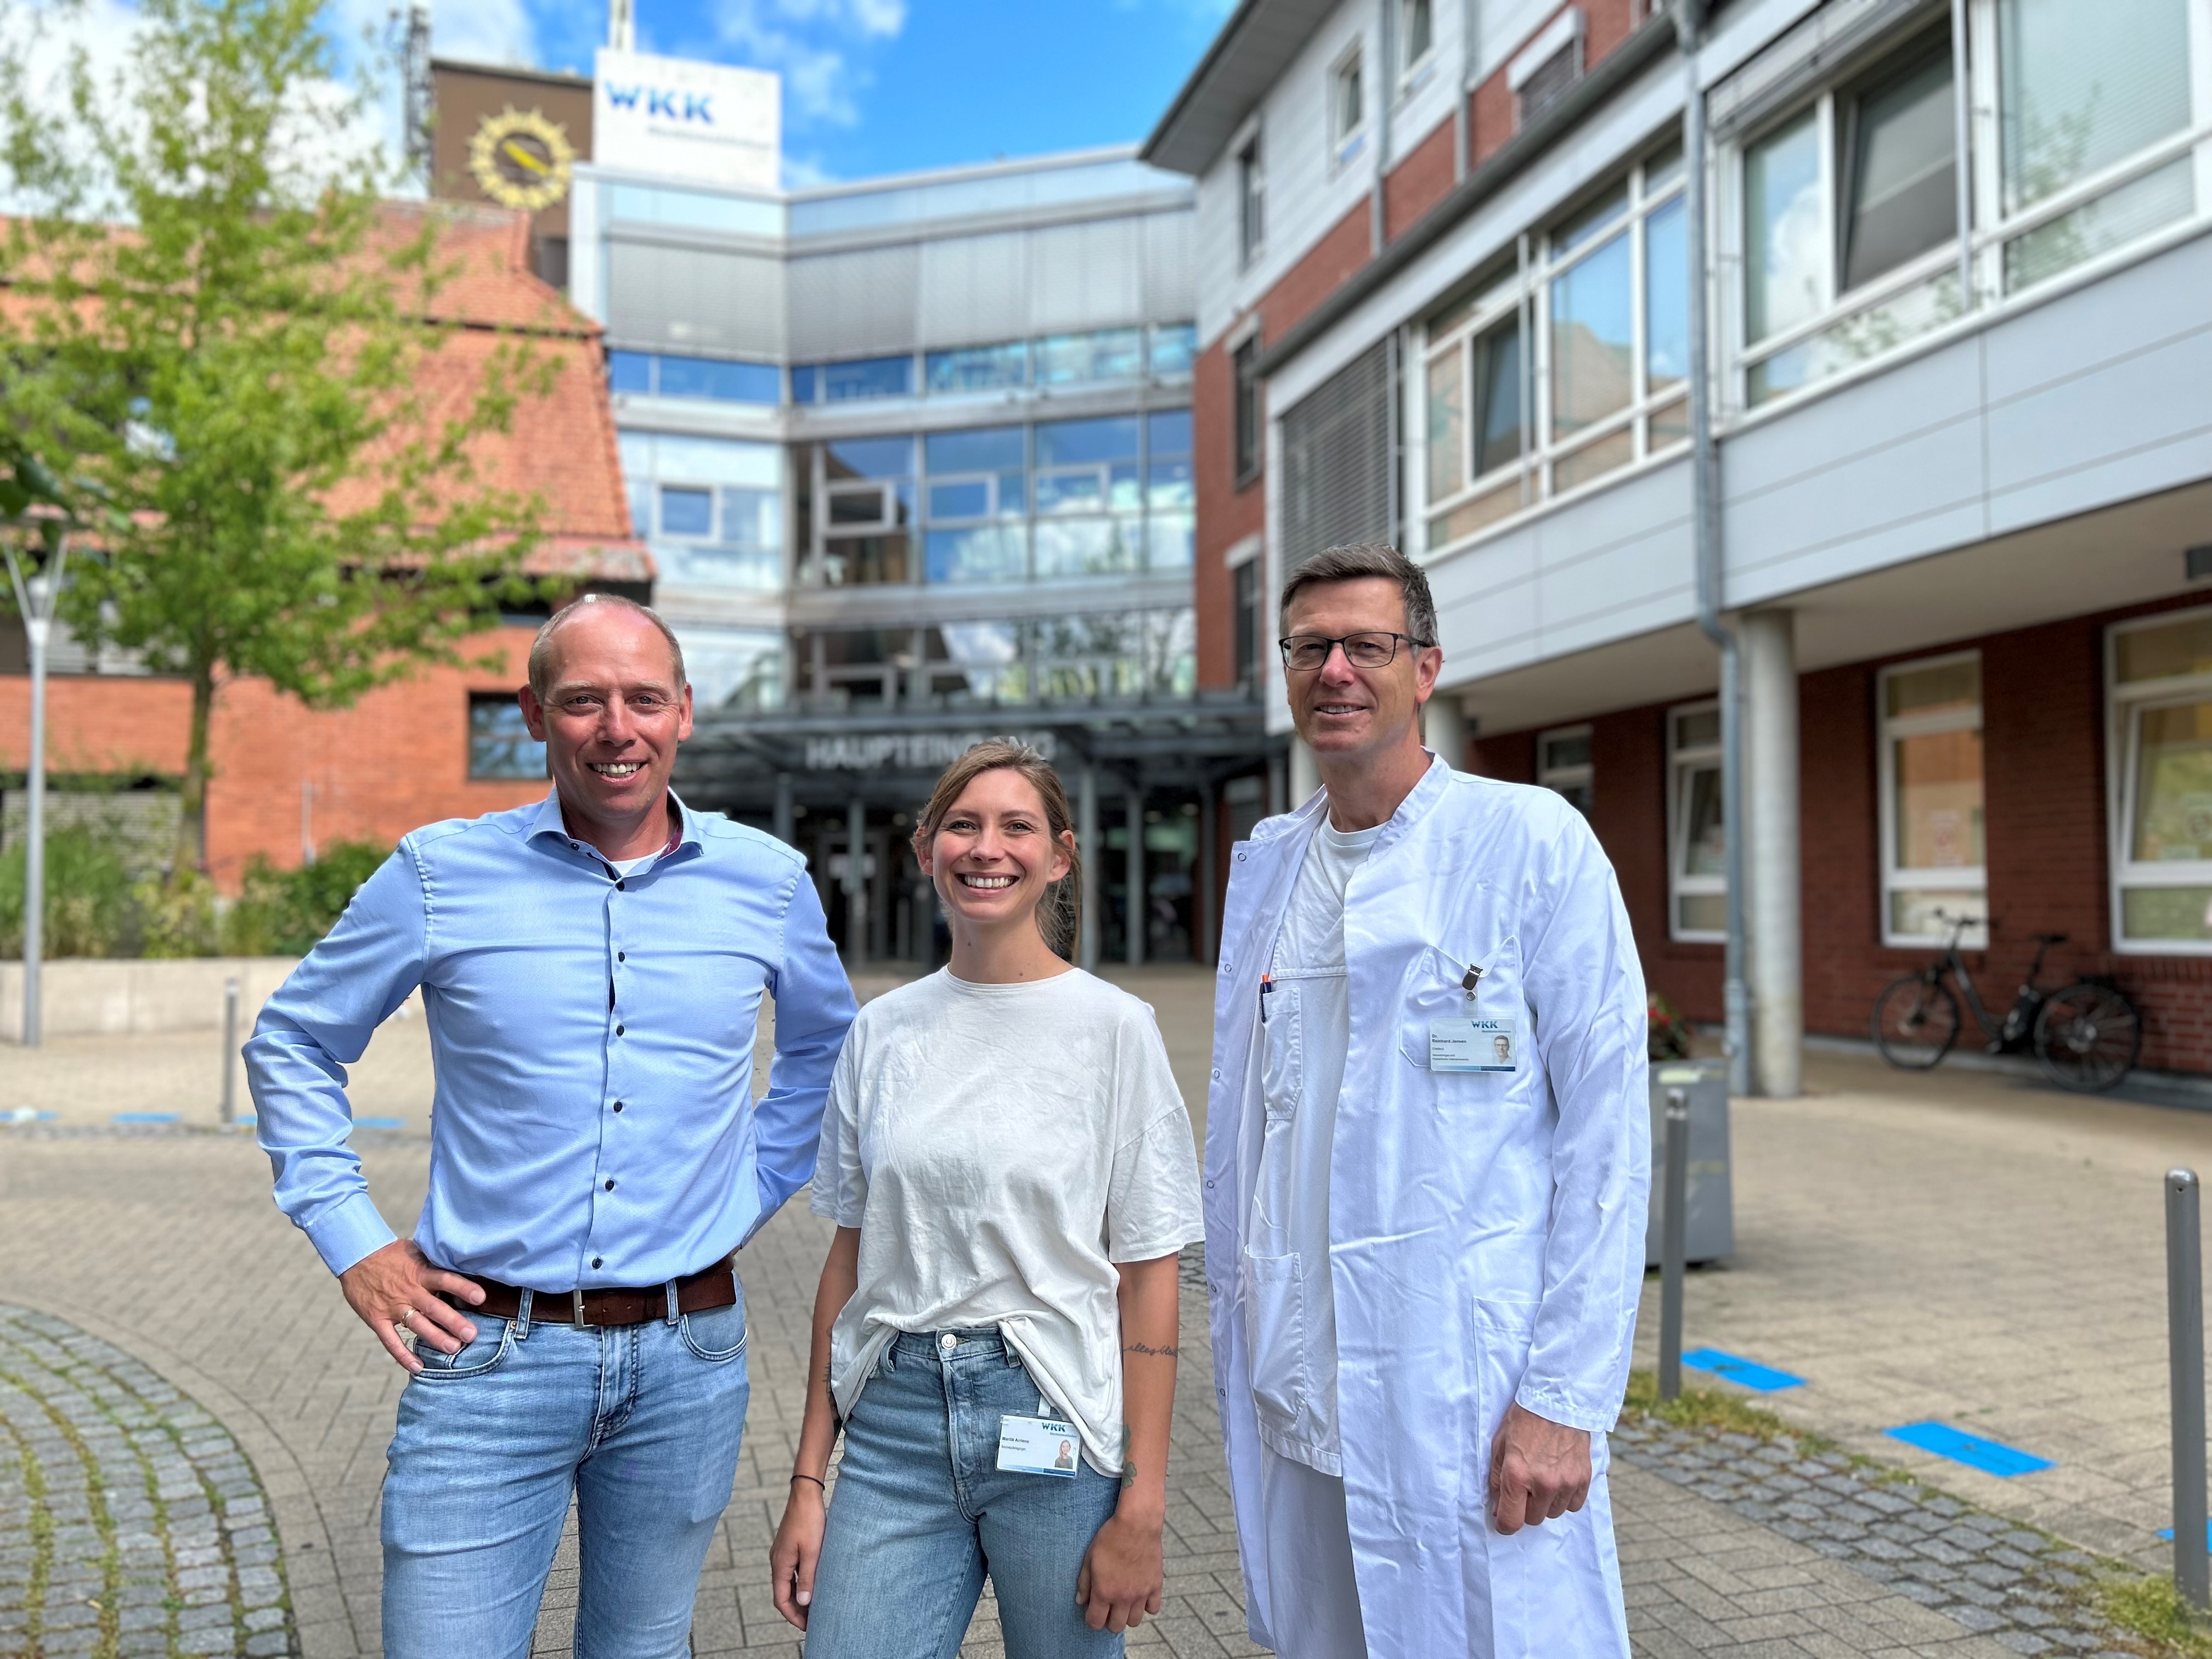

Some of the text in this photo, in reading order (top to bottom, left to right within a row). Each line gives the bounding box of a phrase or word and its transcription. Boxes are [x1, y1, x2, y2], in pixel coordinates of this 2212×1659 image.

[605, 79, 714, 124] WKK
[805, 731, 1057, 770] HAUPTEING
[1471, 1020, 1498, 1029] WKK
[1042, 1422, 1065, 1432] WKK
